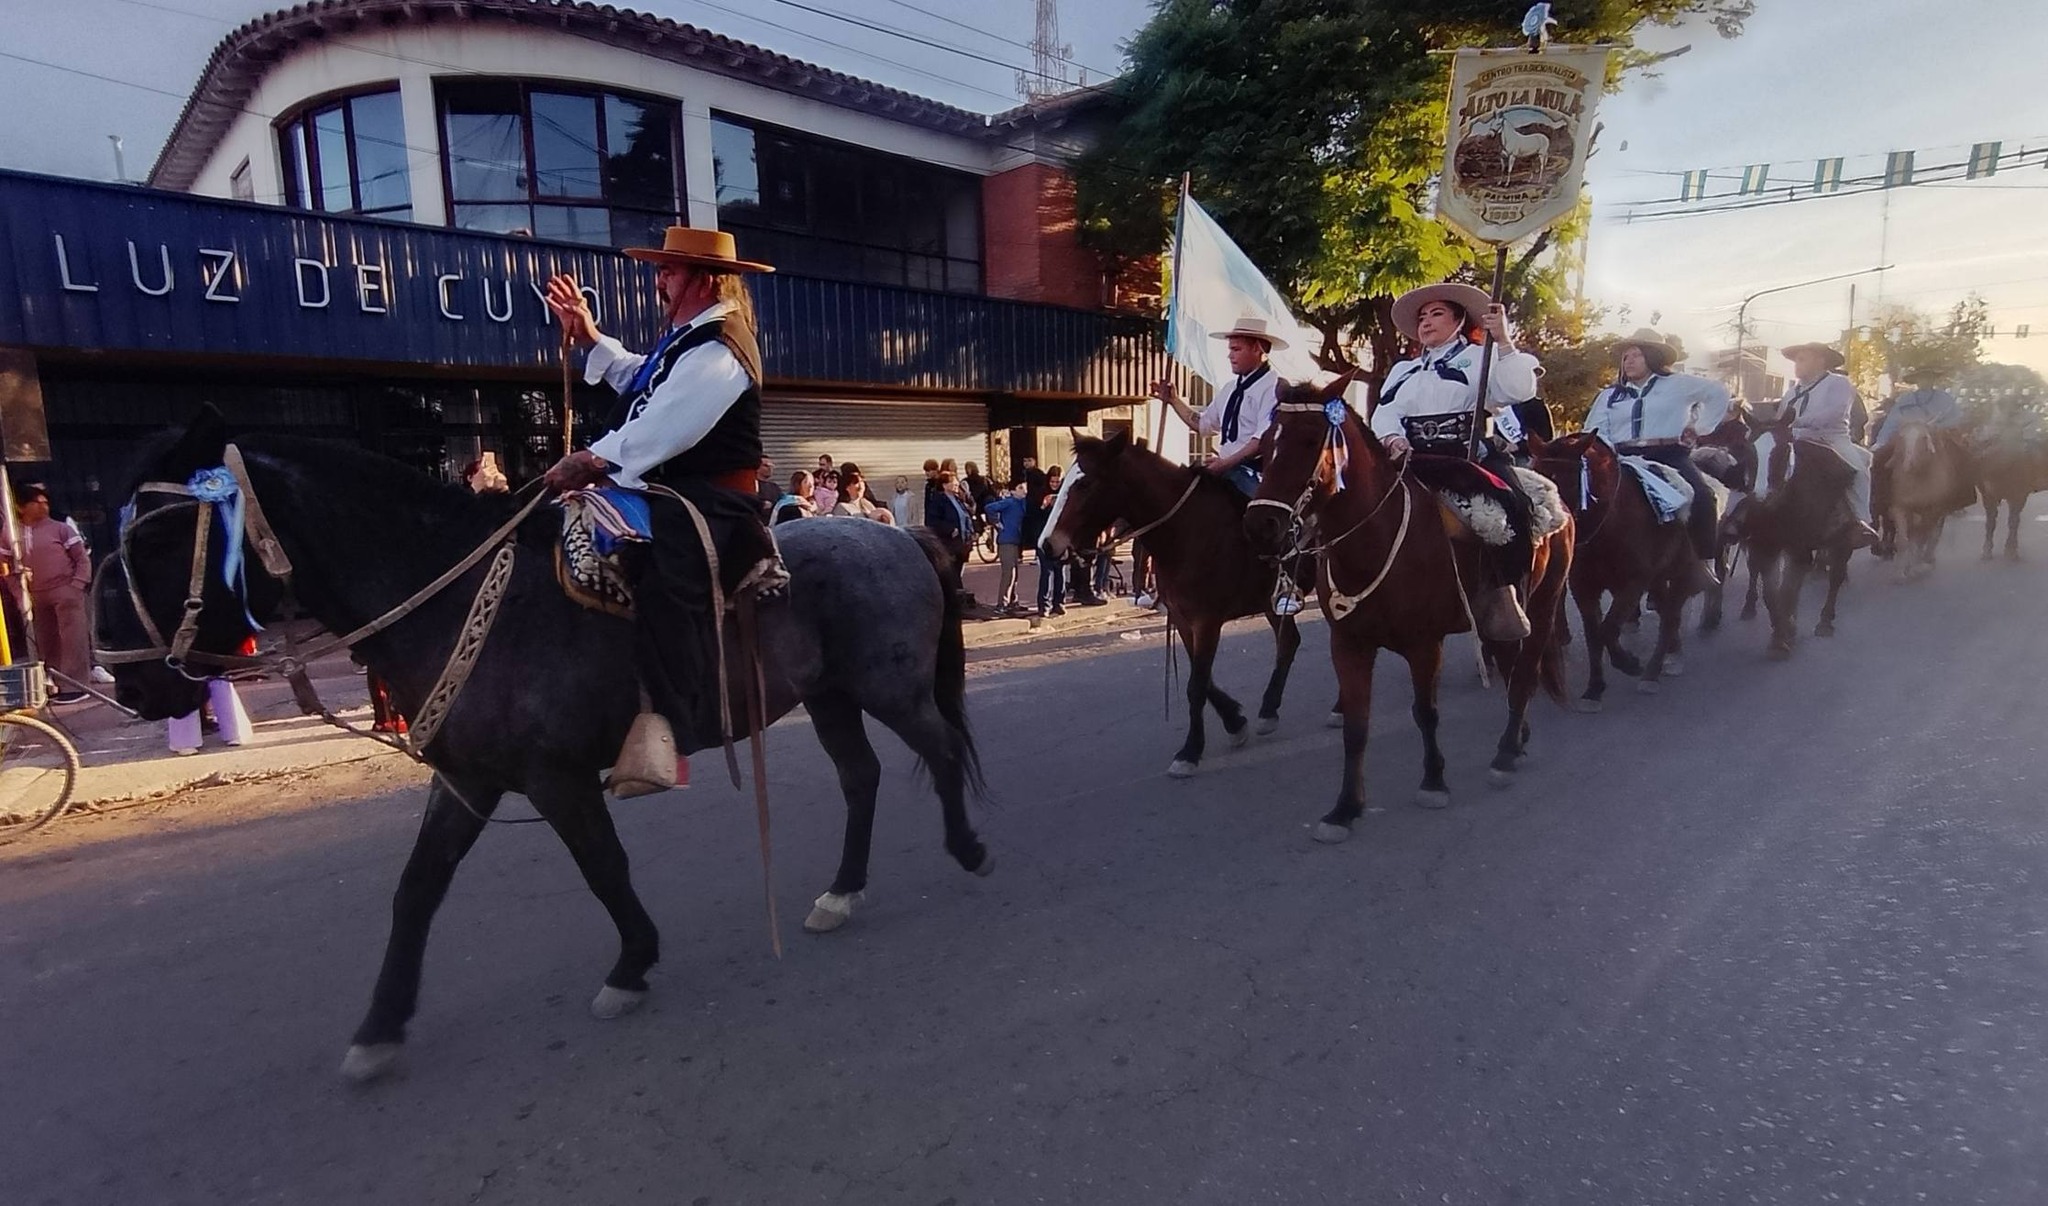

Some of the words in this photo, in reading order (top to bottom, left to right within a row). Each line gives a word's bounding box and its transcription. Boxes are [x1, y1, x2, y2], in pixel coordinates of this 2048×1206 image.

[1481, 66, 1512, 82] CENTRO
[1514, 63, 1577, 80] TRADICIONALISTA
[1459, 91, 1507, 127] ALTO
[1510, 89, 1530, 106] LA
[1534, 88, 1586, 122] MULA
[1484, 191, 1529, 202] PALMIRA
[54, 234, 240, 302] LUZ
[294, 257, 387, 313] DE
